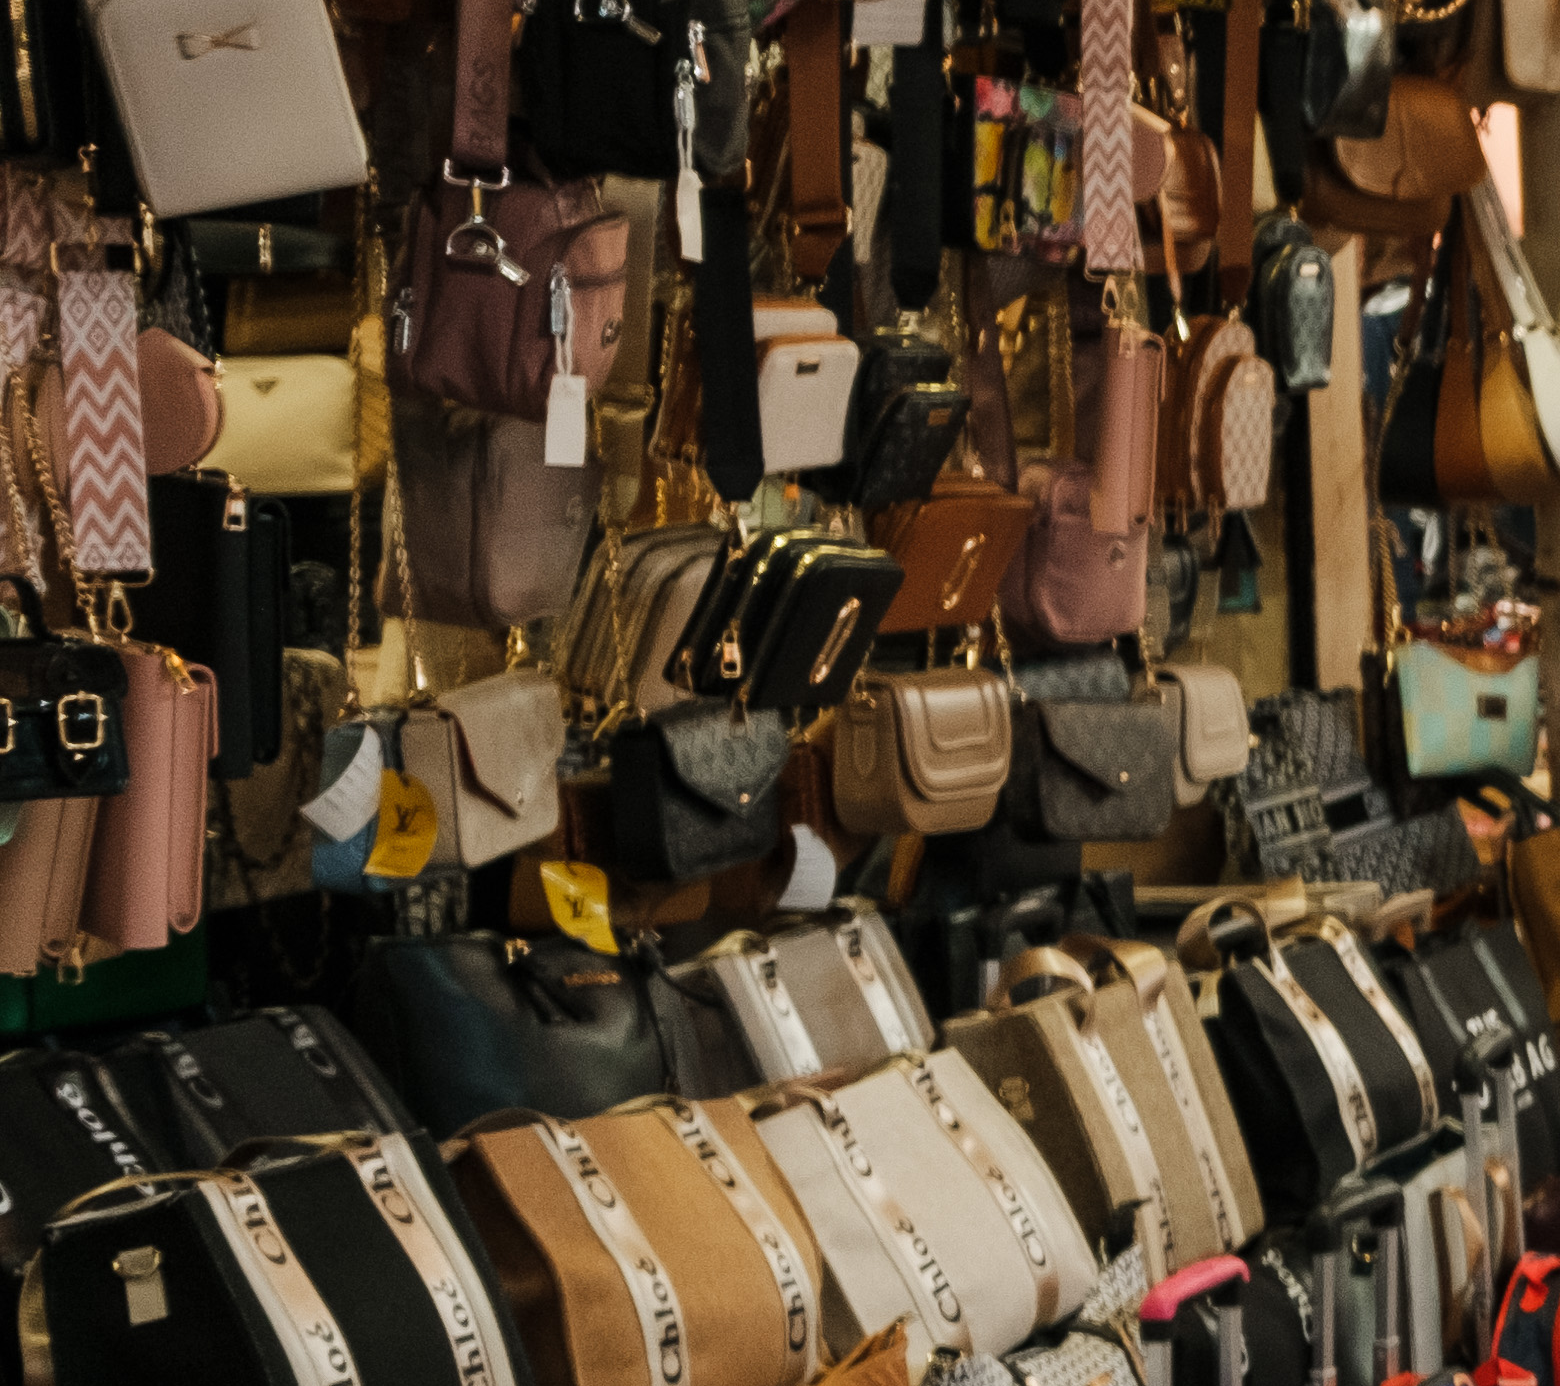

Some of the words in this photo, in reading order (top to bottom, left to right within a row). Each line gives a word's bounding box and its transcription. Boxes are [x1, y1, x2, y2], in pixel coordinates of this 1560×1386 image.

[636, 1256, 683, 1384] Chloé
[763, 1231, 807, 1352] Chloé
[896, 1215, 961, 1323] Chloé
